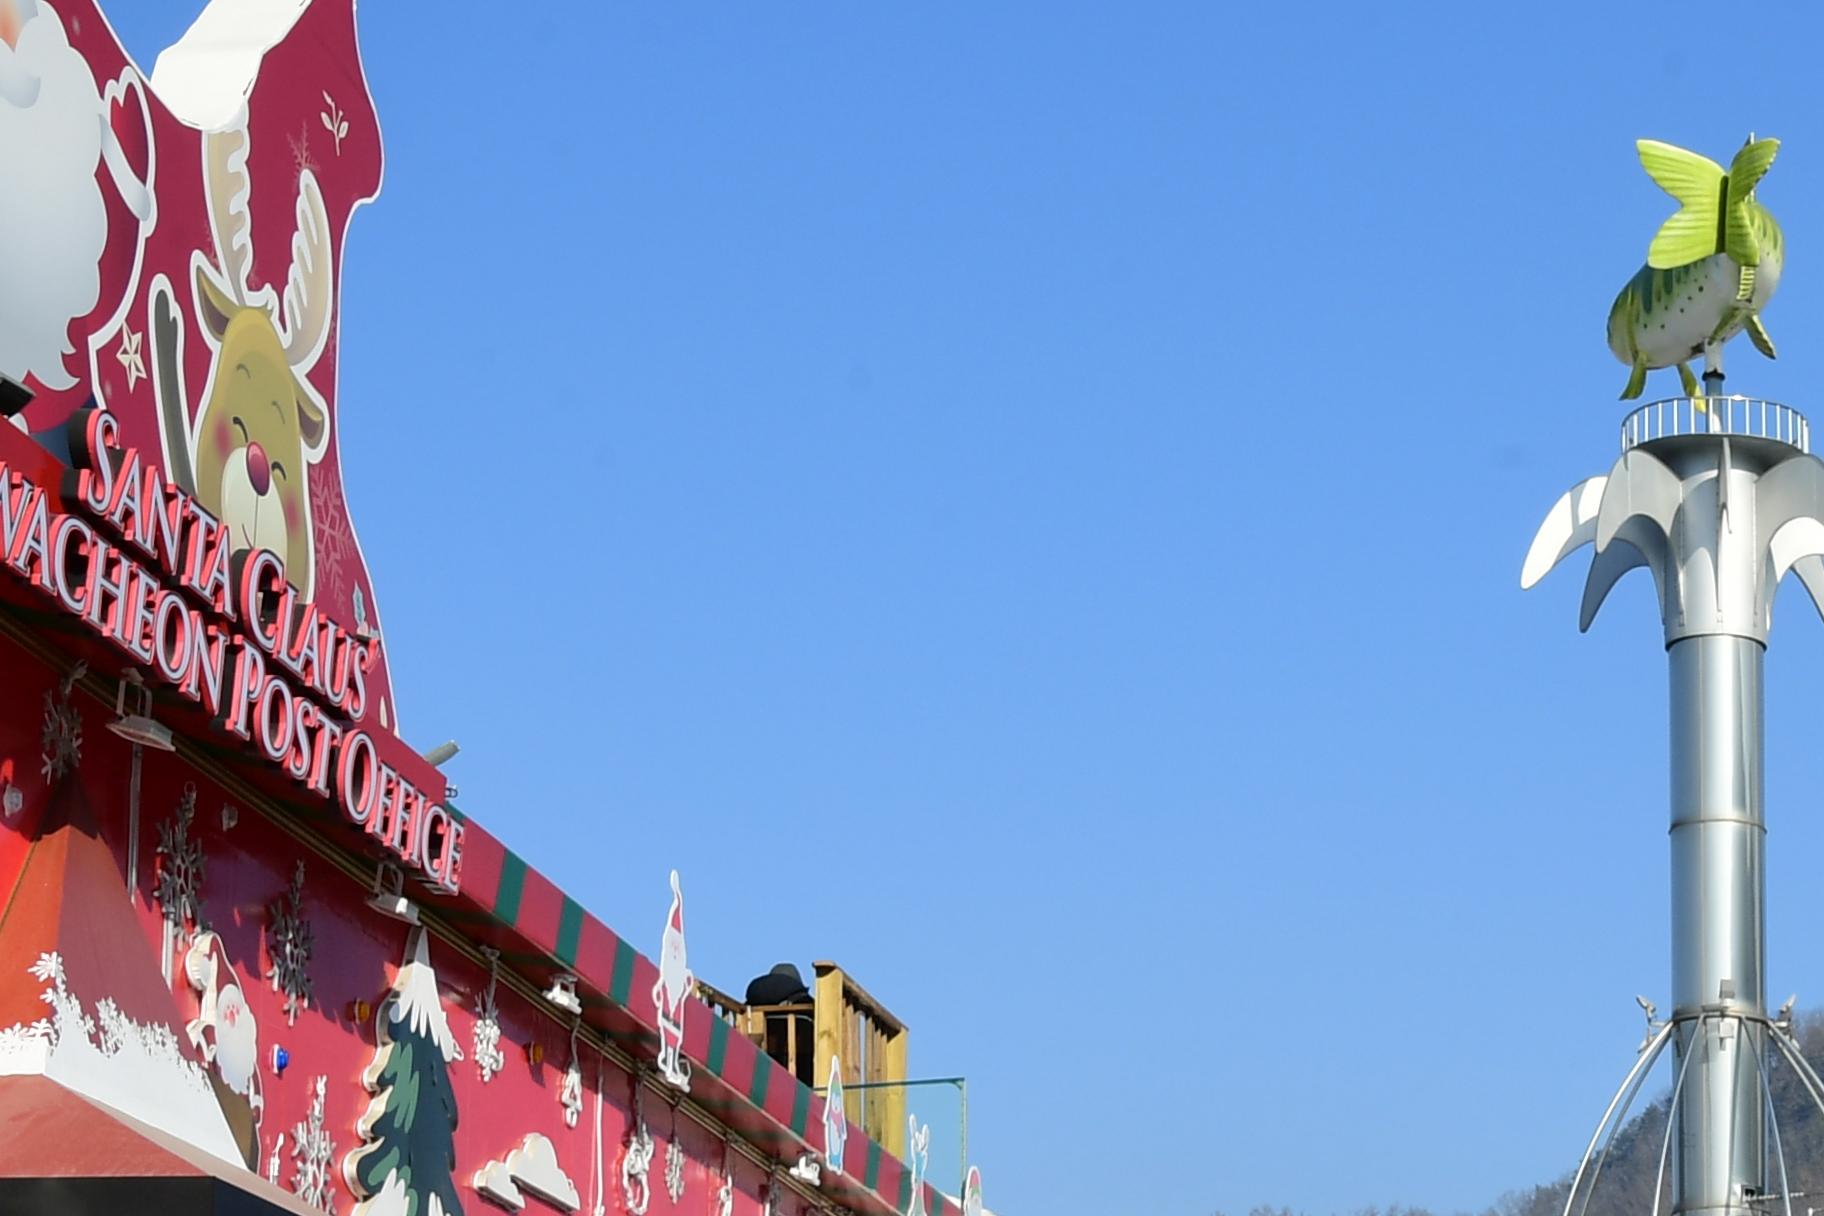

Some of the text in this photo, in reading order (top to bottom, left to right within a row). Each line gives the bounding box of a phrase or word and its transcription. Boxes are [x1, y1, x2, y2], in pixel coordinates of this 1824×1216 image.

[80, 409, 372, 722] SANTA CLAUS
[226, 635, 342, 799] POST
[337, 729, 464, 897] OFFICE
